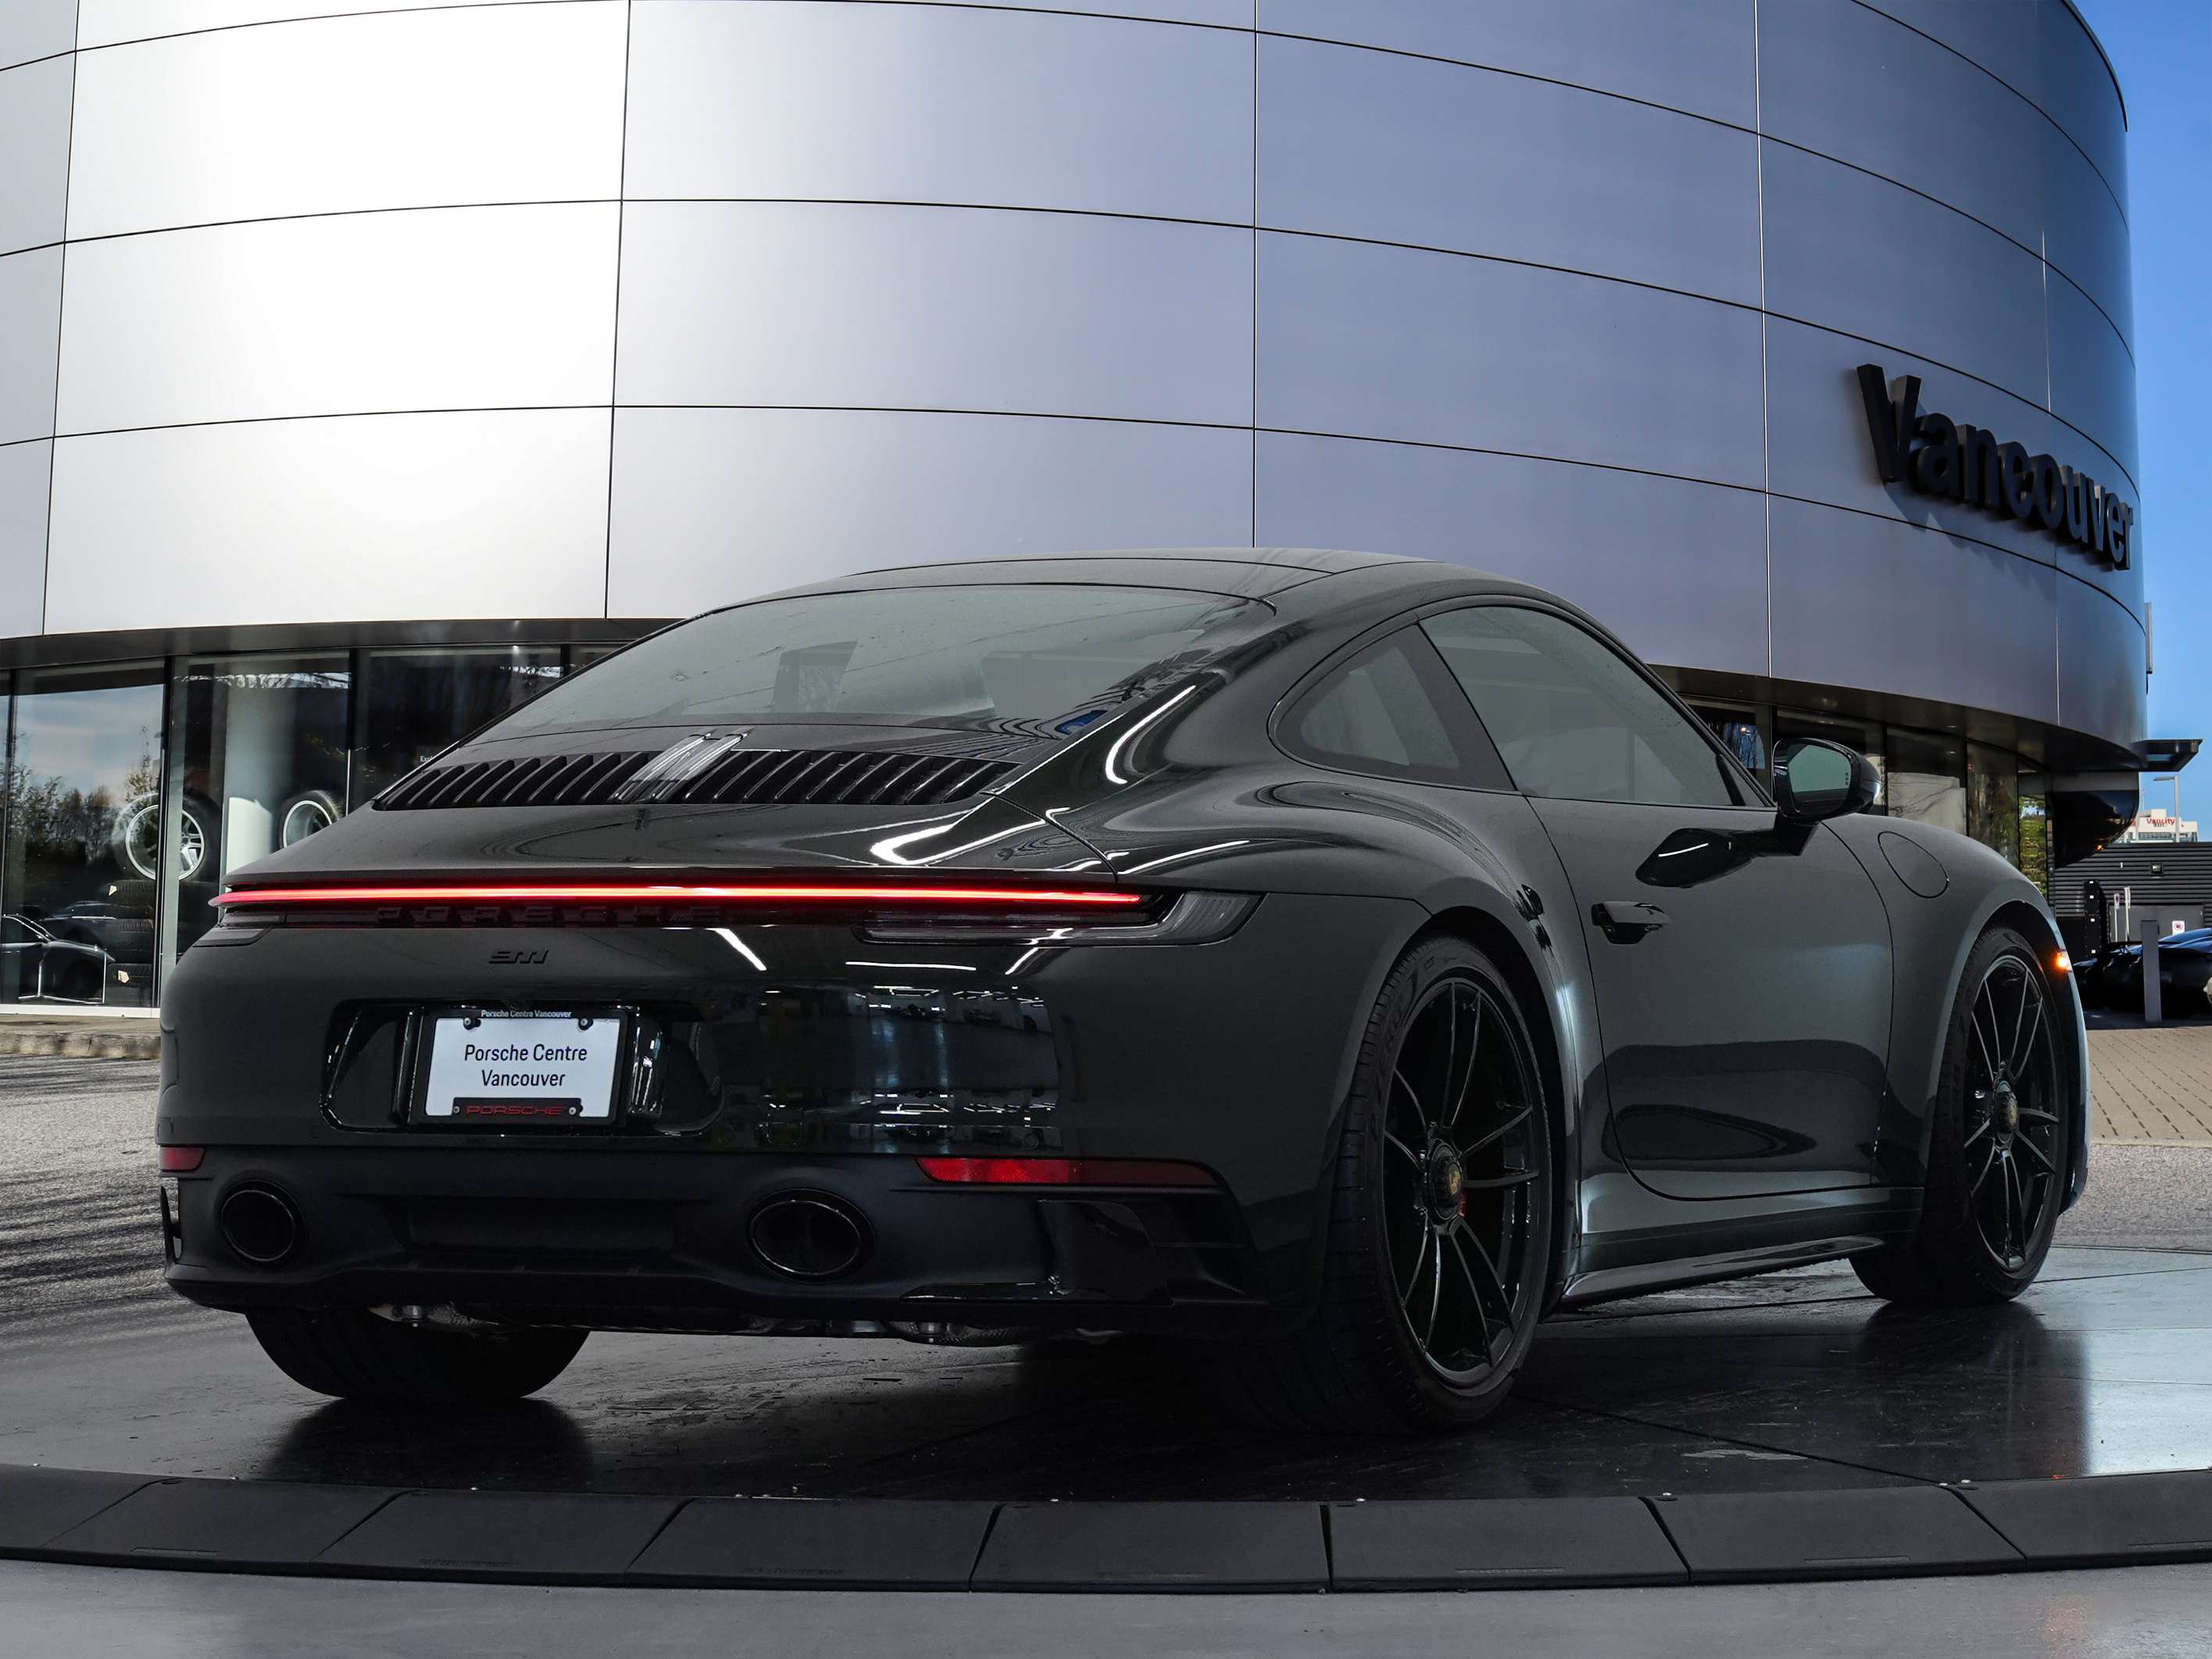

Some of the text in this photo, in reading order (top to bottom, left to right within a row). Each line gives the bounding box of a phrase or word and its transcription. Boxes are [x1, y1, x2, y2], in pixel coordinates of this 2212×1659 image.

[1856, 363, 2134, 570] Vancouver
[488, 949, 549, 964] 911
[464, 1044, 588, 1061] Porsche Centre
[481, 1070, 566, 1087] Vancouver
[466, 1106, 563, 1115] PORSCHE
